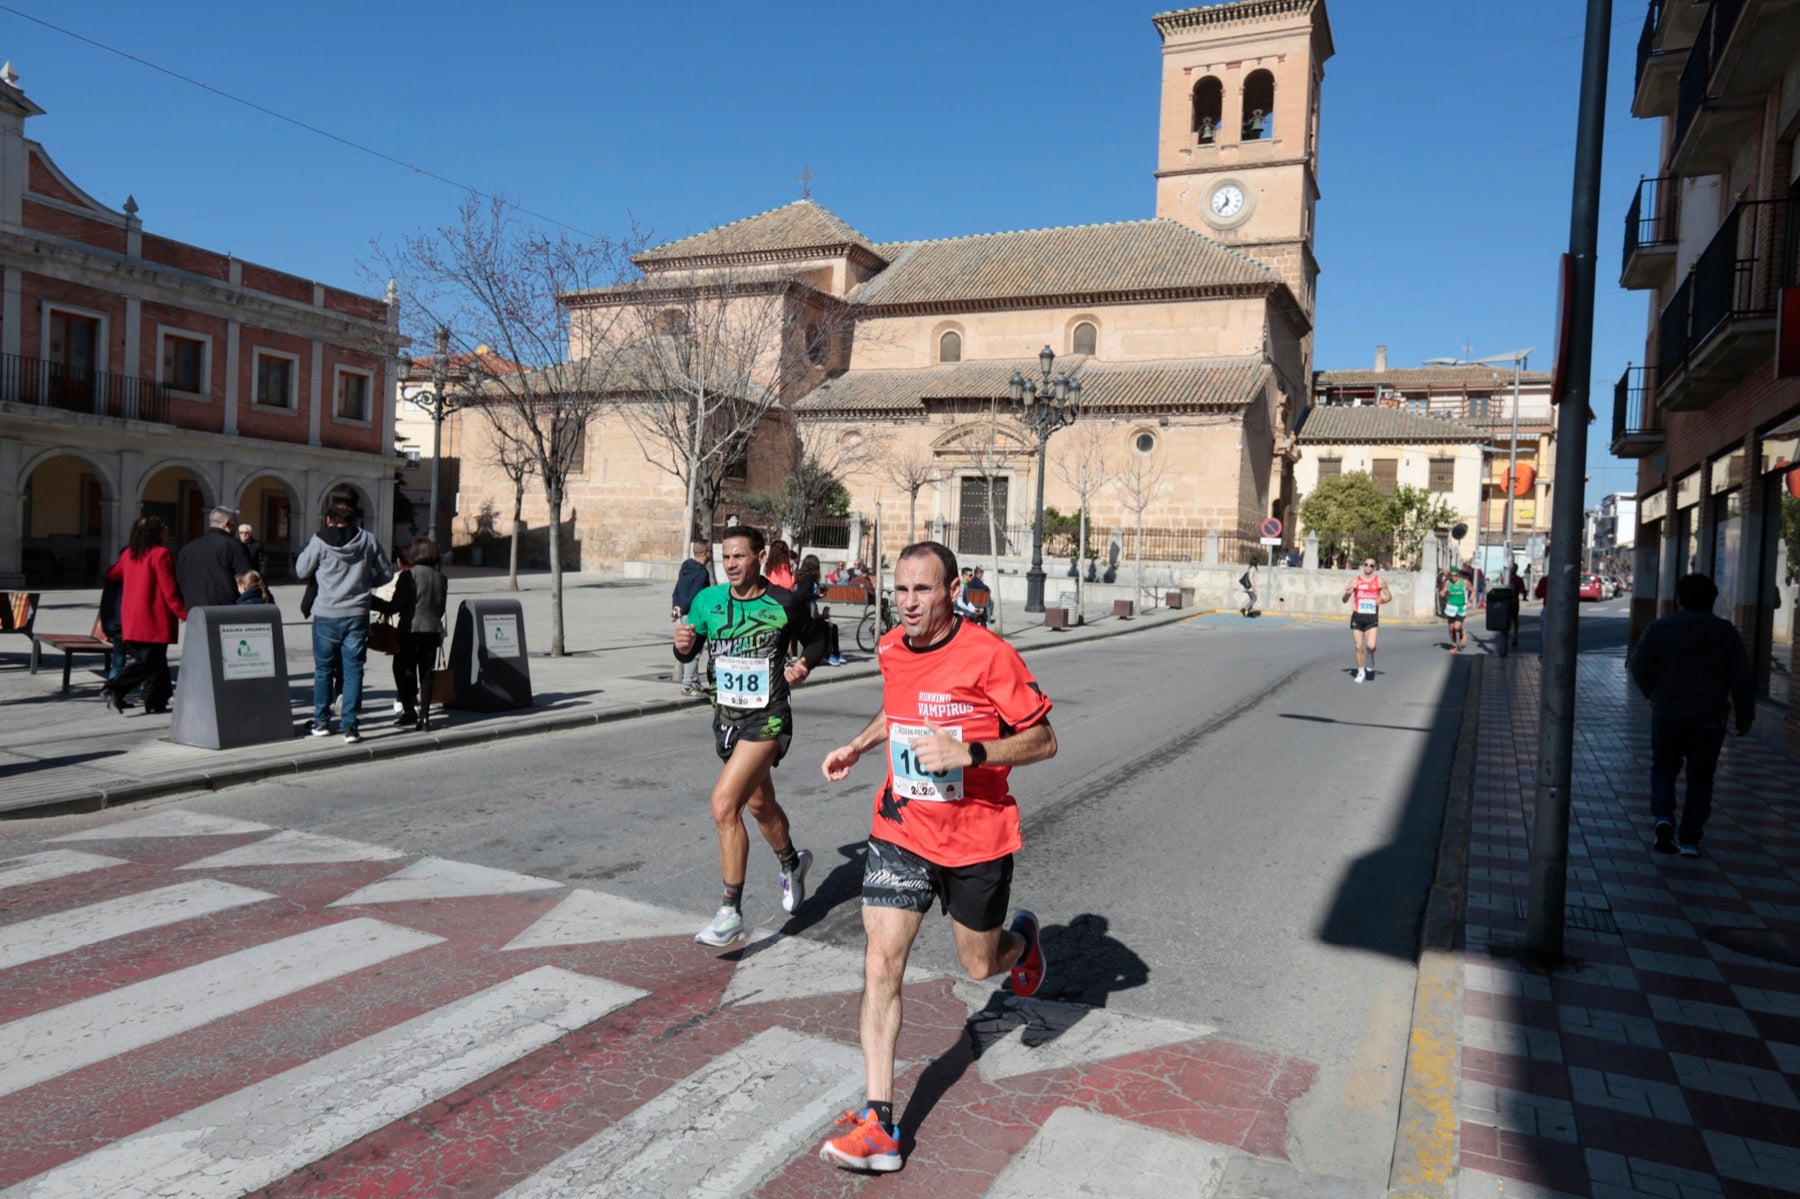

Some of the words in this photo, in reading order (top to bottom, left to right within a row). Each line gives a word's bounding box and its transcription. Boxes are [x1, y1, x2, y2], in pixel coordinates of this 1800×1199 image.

[724, 672, 760, 692] 318
[918, 691, 952, 703] RUNNING
[918, 702, 974, 718] VAMPIROS
